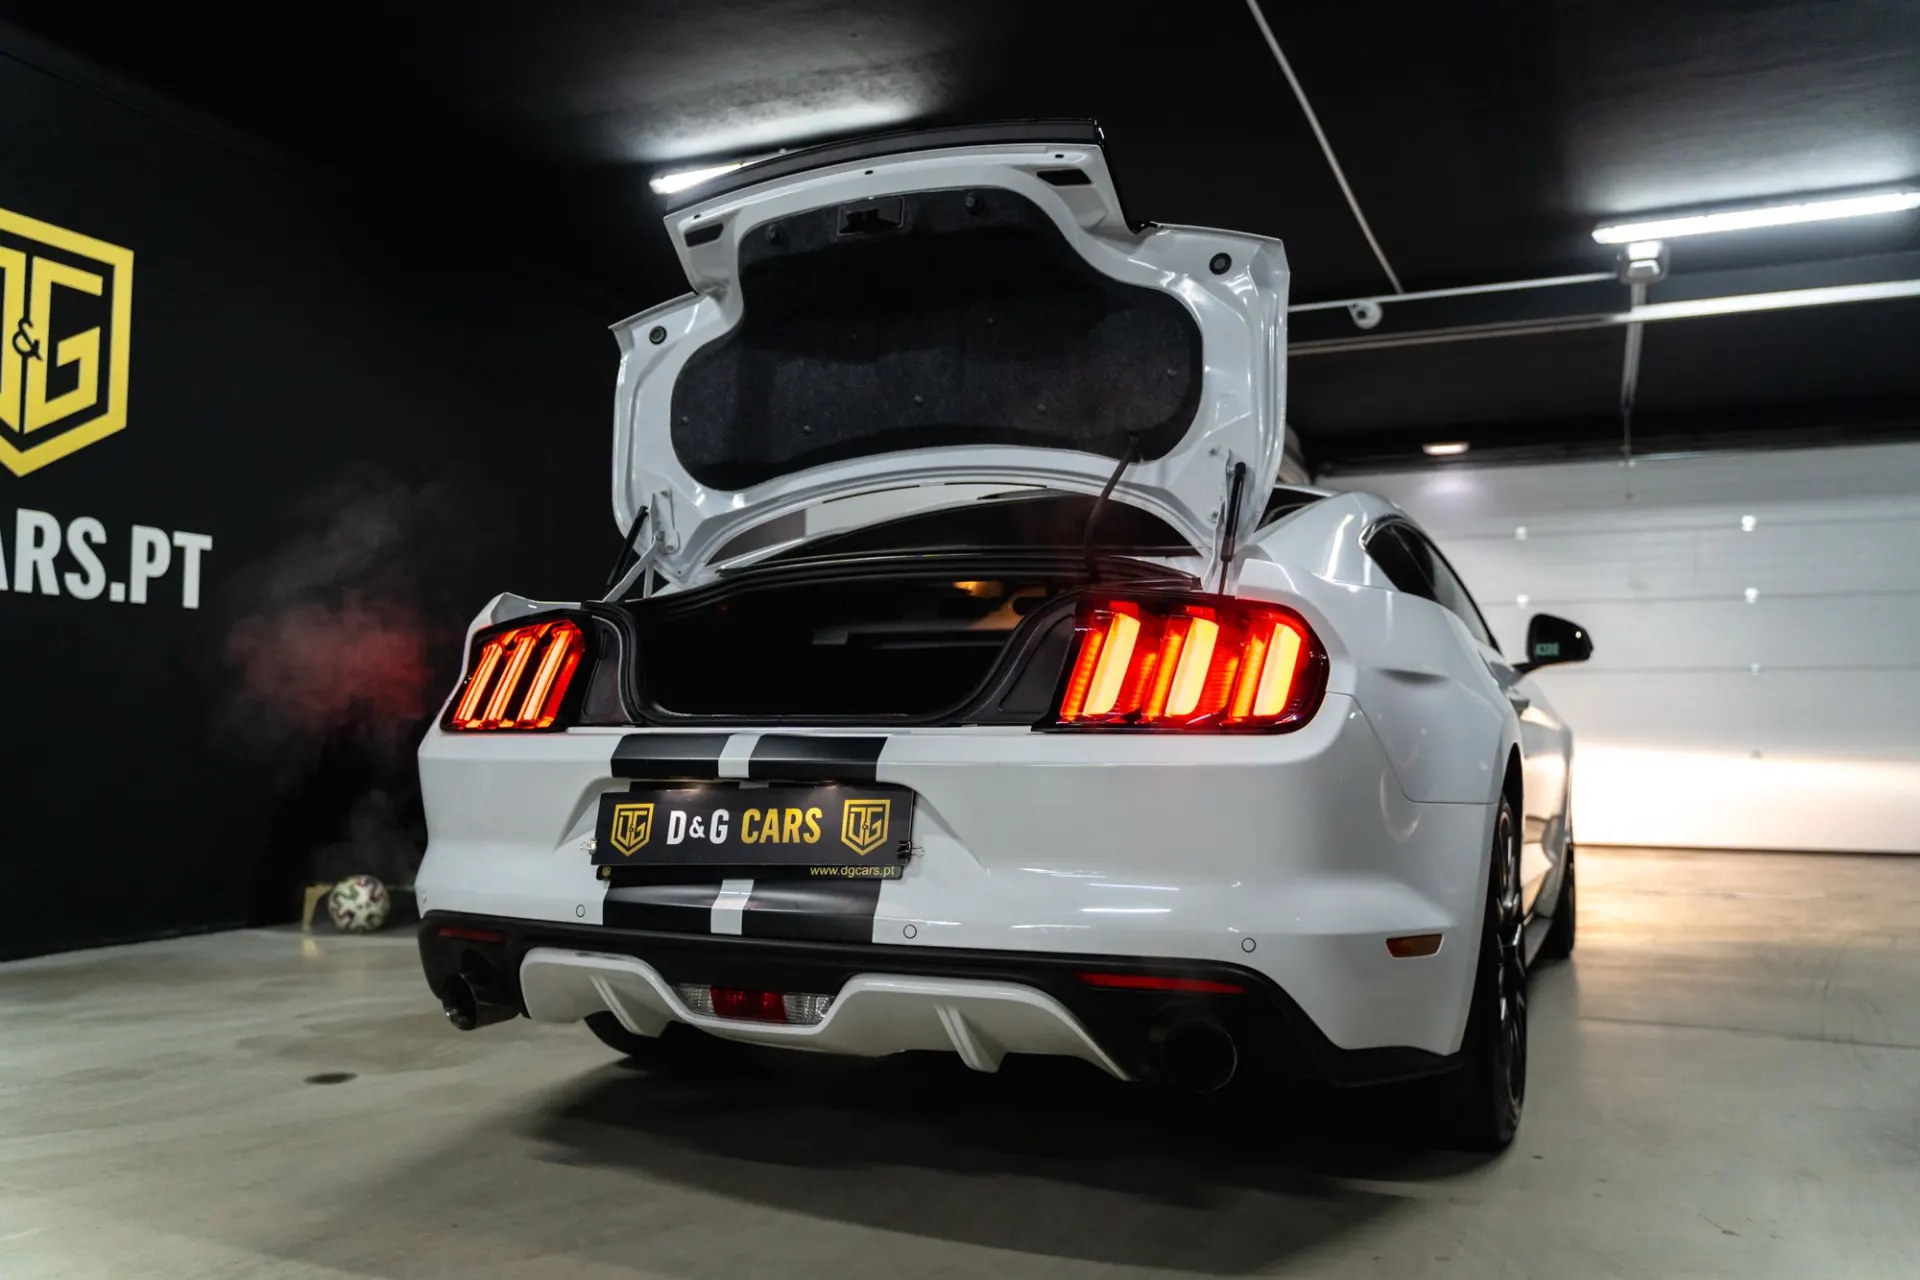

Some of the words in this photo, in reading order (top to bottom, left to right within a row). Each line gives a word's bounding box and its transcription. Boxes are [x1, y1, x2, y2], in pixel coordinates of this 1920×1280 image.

[0, 508, 212, 610] RS.PT
[666, 808, 730, 845] D&G
[740, 807, 823, 844] CARS
[809, 865, 896, 878] www.dgcars.pt
